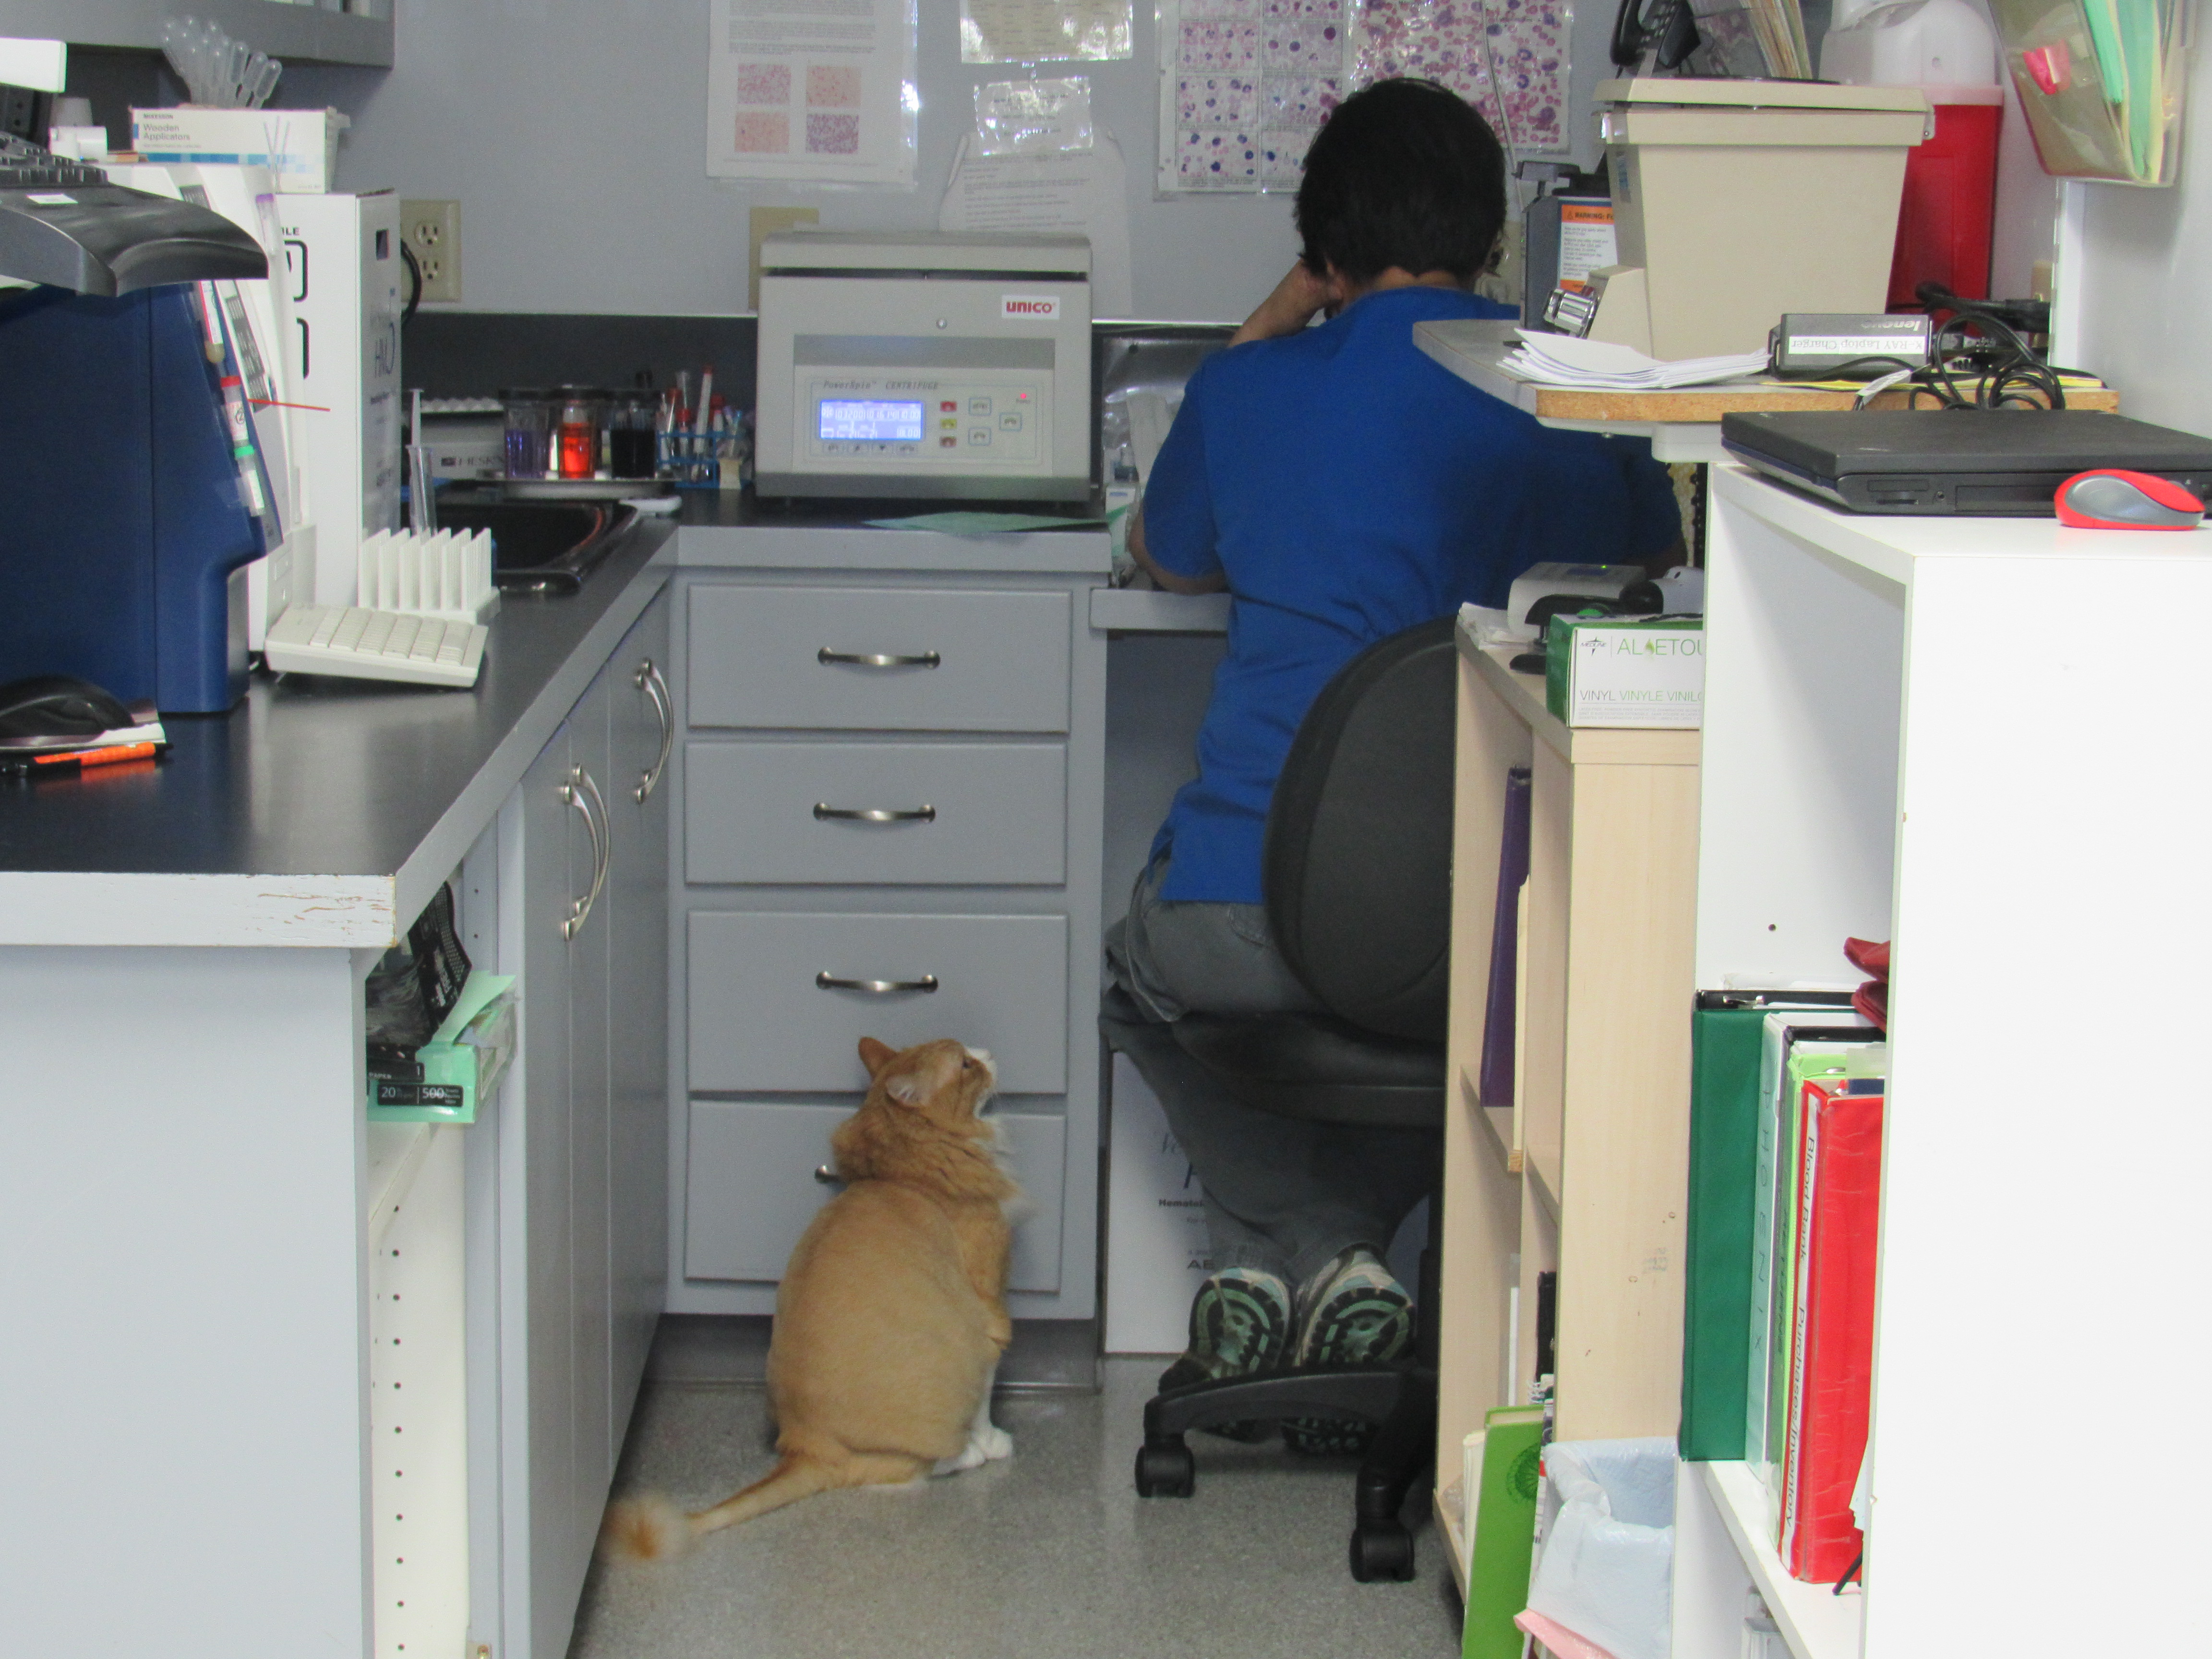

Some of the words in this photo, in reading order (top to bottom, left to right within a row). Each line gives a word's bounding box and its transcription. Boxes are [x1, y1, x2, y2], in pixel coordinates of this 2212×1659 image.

[143, 123, 180, 132] Wooden
[143, 132, 191, 141] Applicators
[1861, 320, 1921, 331] lenovo
[1791, 339, 1837, 350] Charger
[1840, 339, 1879, 350] Laptop
[1884, 340, 1924, 350] X-RAY
[1580, 689, 1616, 701] VINYL
[1619, 690, 1664, 701] VINYLE
[422, 1087, 445, 1099] 500
[1804, 1137, 1815, 1200] Blood
[1800, 1207, 1810, 1262] Bank
[1786, 1307, 1805, 1527] Purchases/Inventory
